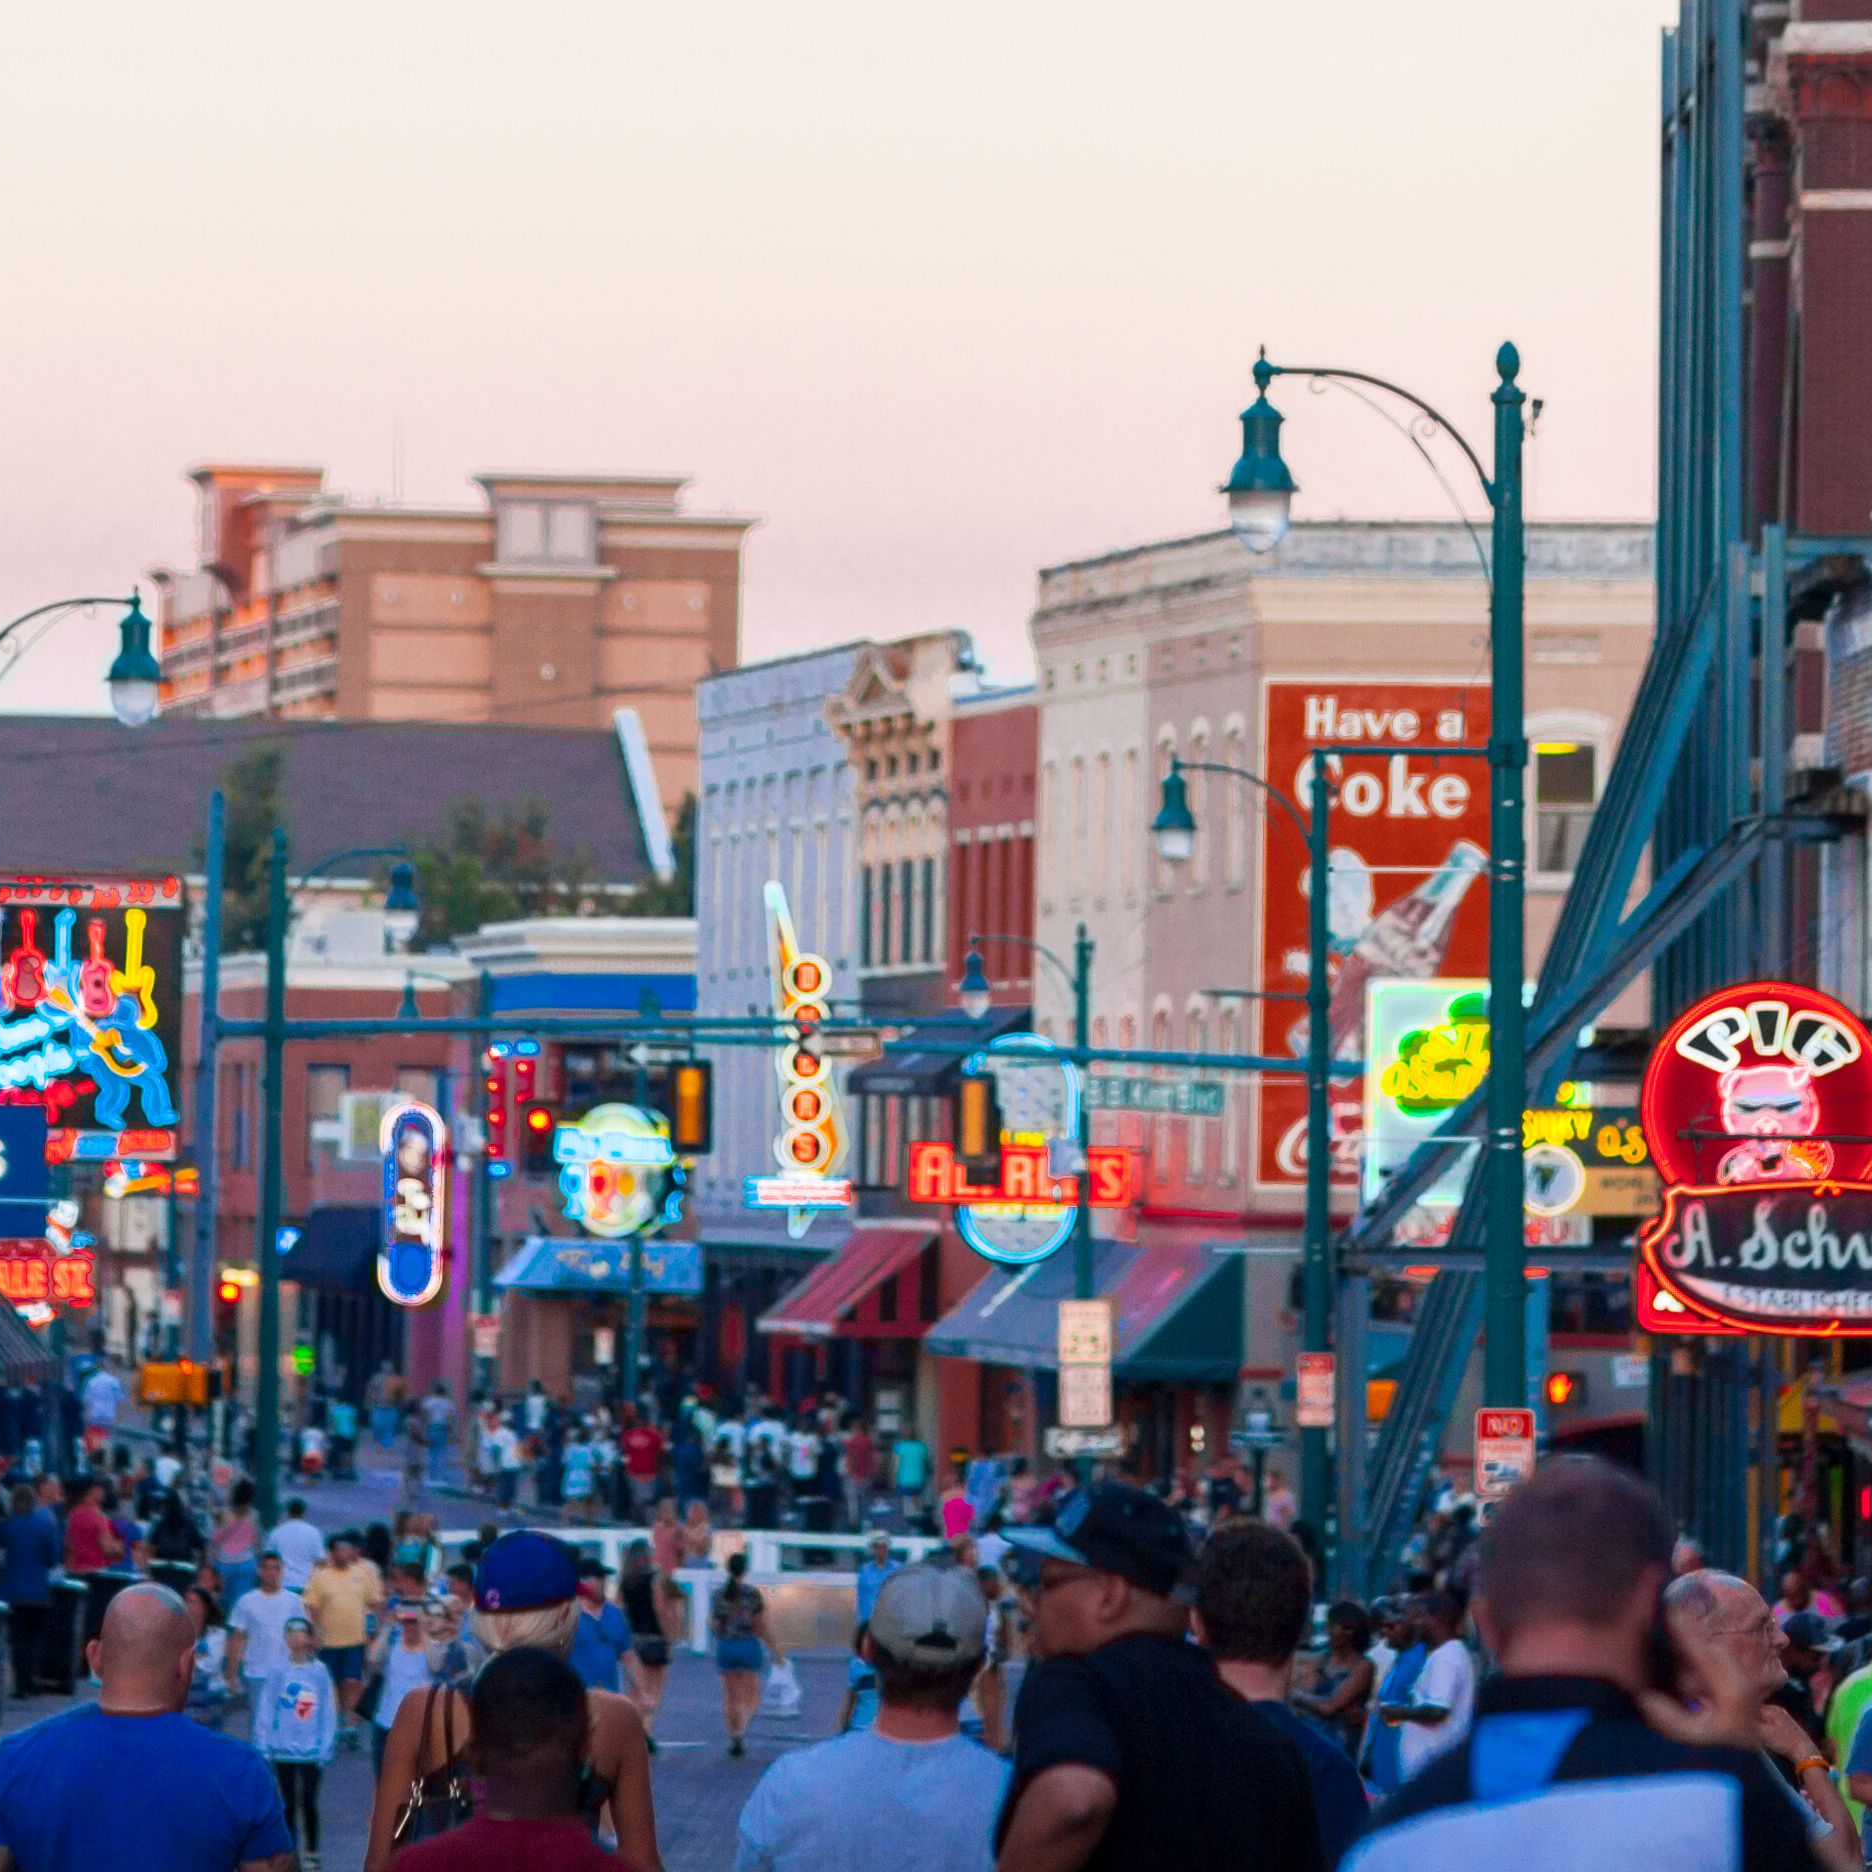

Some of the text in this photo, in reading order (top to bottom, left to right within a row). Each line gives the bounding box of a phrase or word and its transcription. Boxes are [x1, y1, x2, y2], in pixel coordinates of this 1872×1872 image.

[1305, 696, 1466, 743] Have a
[1676, 1000, 1862, 1077] PIG
[1661, 1200, 1731, 1268] A.
